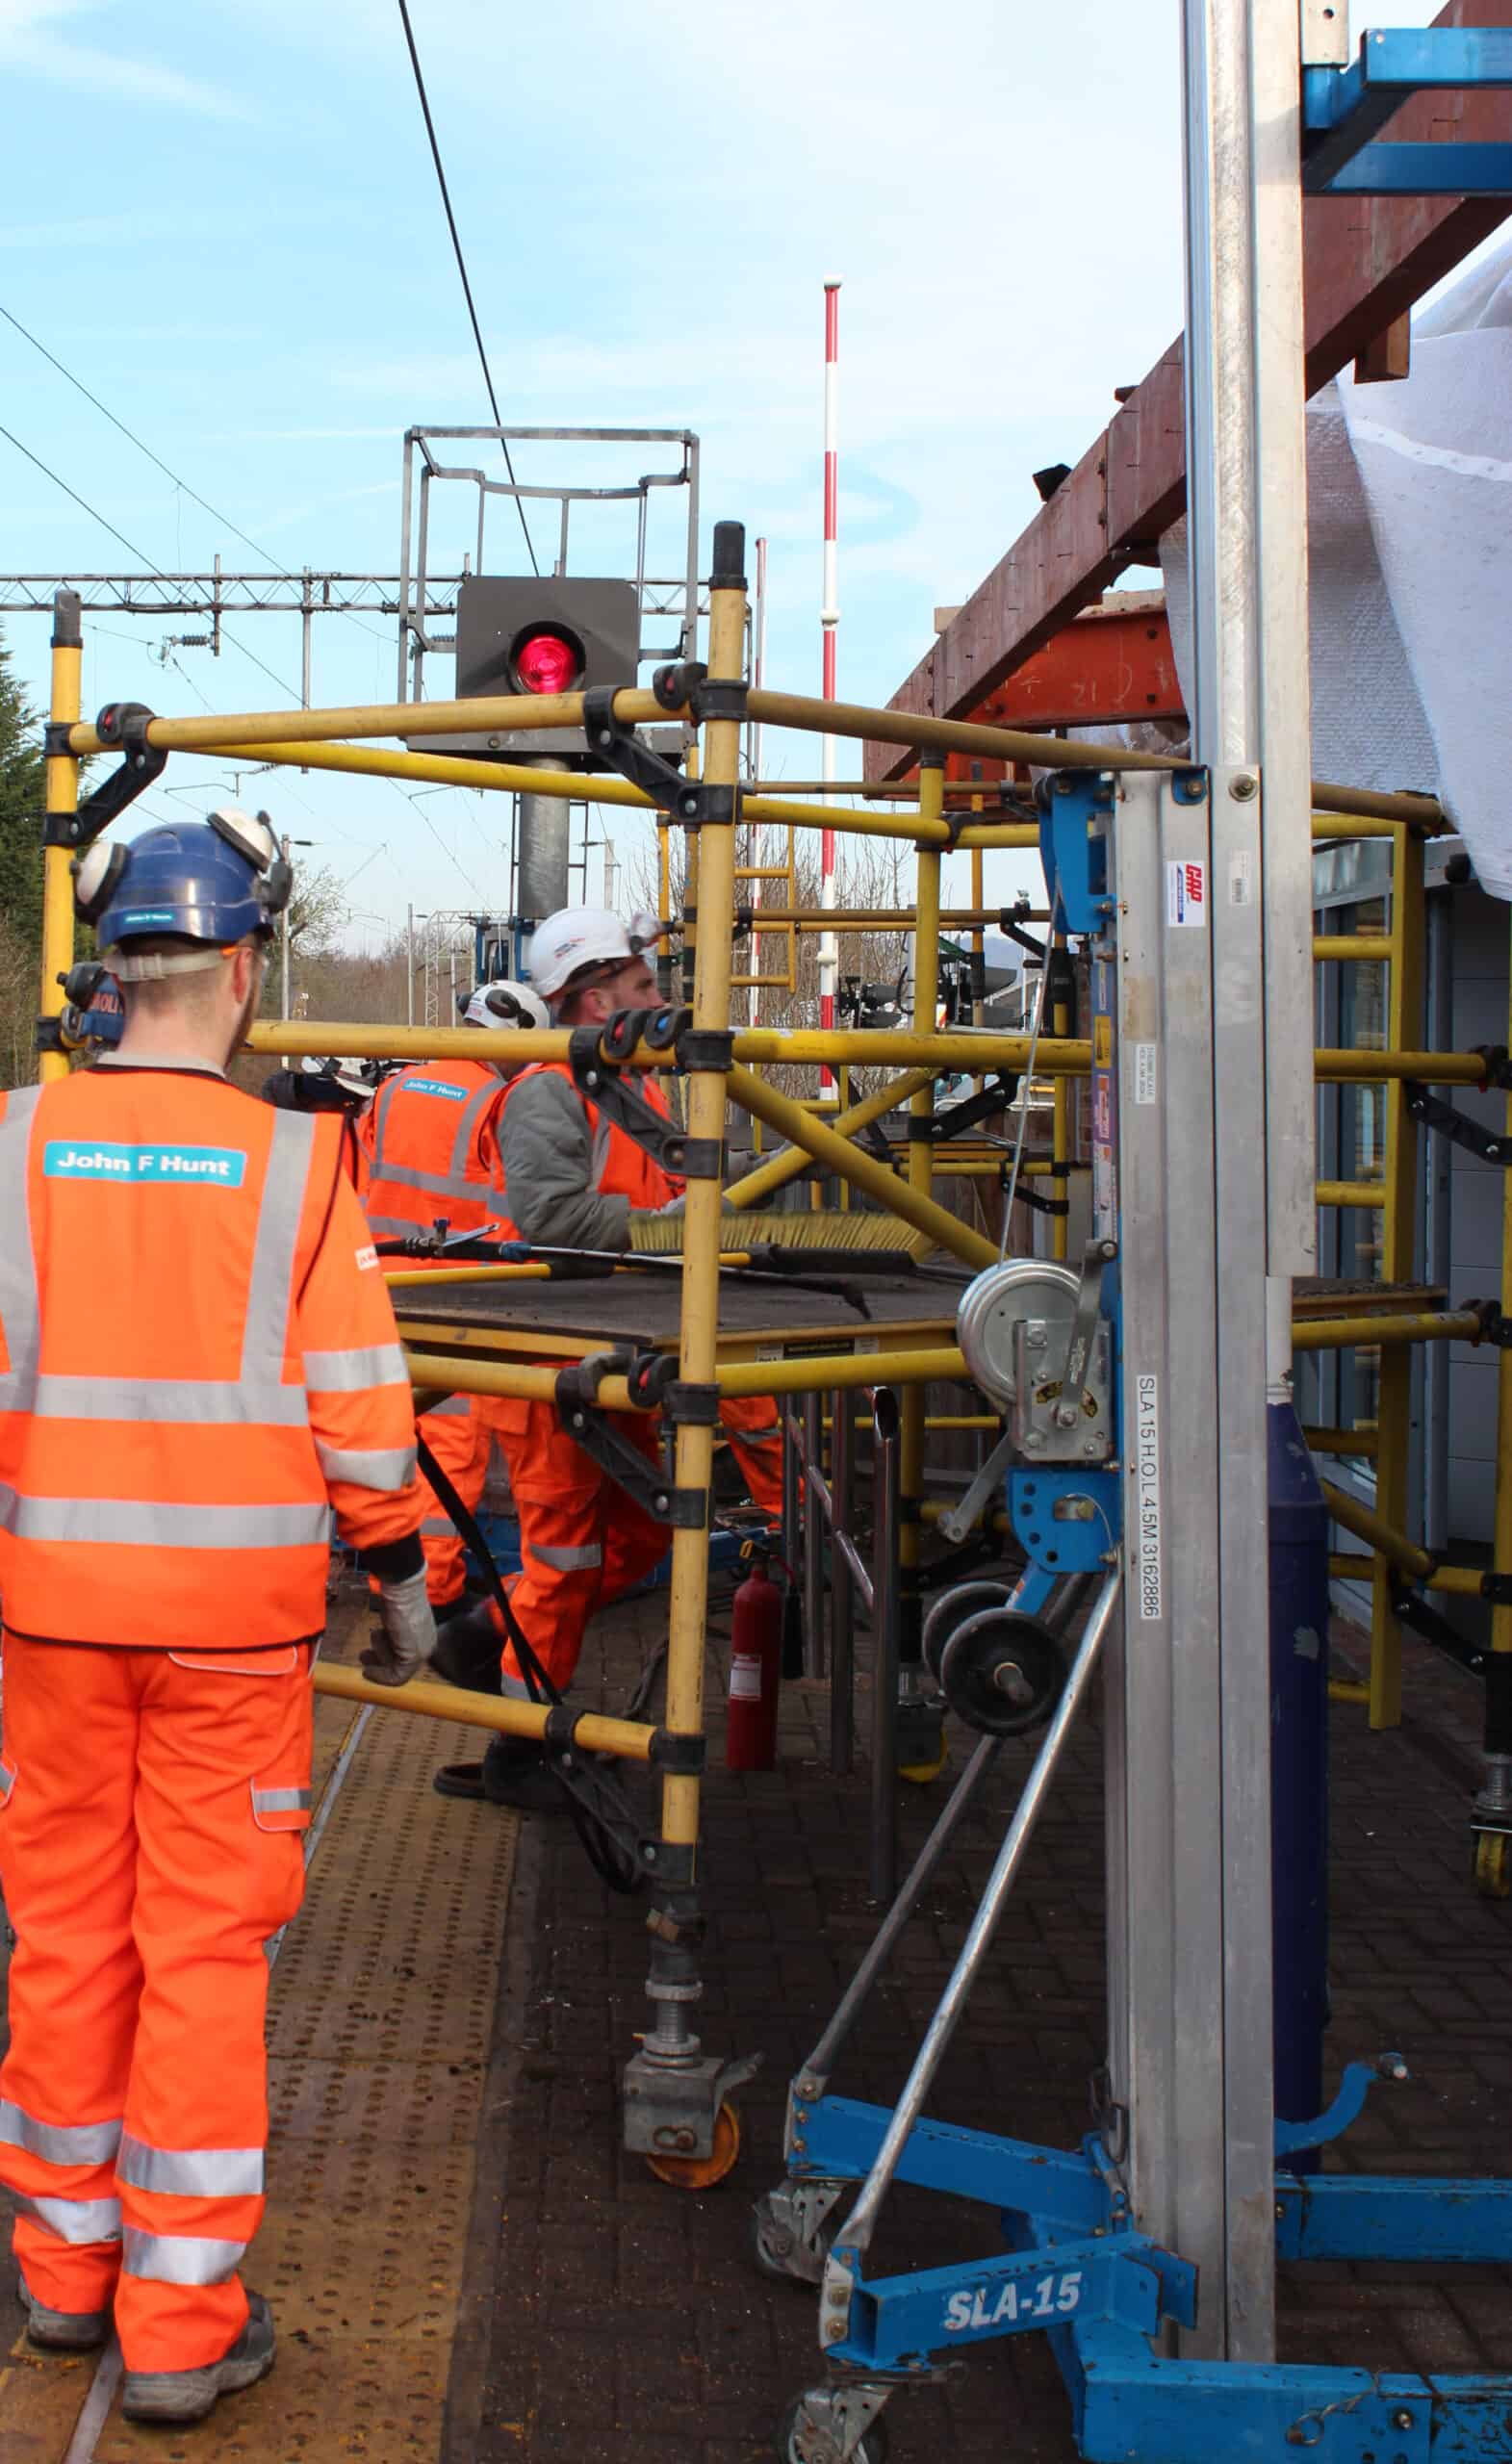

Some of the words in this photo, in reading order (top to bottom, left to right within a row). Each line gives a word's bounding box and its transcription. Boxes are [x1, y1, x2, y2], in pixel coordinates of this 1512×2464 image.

[58, 1151, 131, 1171] John
[138, 1155, 154, 1170] F
[160, 1155, 231, 1176] Hunt
[1139, 1377, 1155, 1413] SLA
[1140, 1419, 1156, 1439] 15
[1140, 1444, 1157, 1493] H.O.L
[1141, 1497, 1158, 1539] 4.5M
[1142, 1543, 1159, 1617] 3162886
[943, 2272, 1083, 2331] SLA-15
